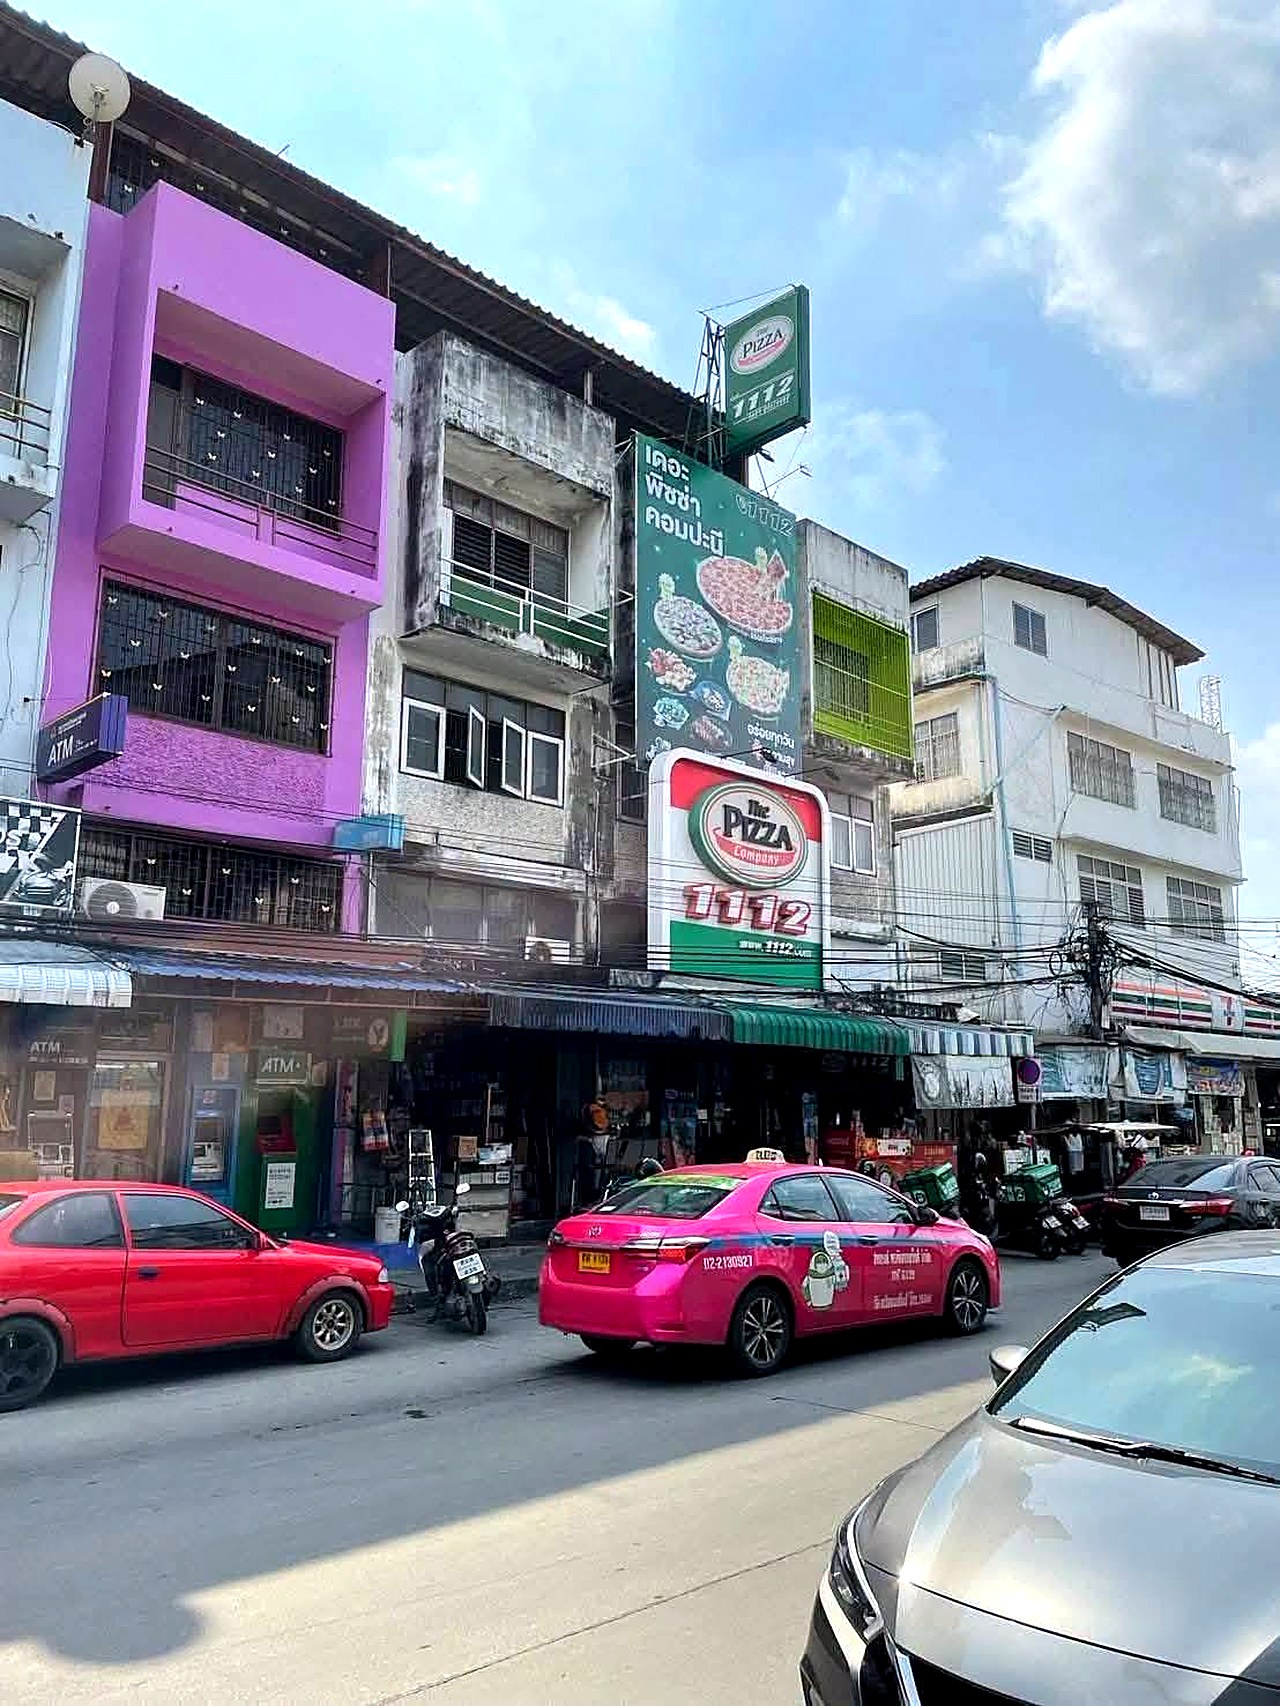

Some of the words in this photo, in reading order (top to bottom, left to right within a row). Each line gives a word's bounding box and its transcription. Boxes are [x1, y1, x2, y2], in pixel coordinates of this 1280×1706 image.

[743, 329, 783, 359] PIZZA
[732, 375, 794, 419] 1112
[645, 444, 689, 481] เดอะ
[645, 505, 724, 557] คอมปะนี
[47, 735, 73, 767] ATM
[748, 799, 770, 818] The
[723, 804, 793, 852] PIZZA
[734, 845, 779, 867] Company
[683, 884, 811, 935] 1112
[29, 1040, 61, 1055] ATM
[261, 1057, 294, 1073] ATM
